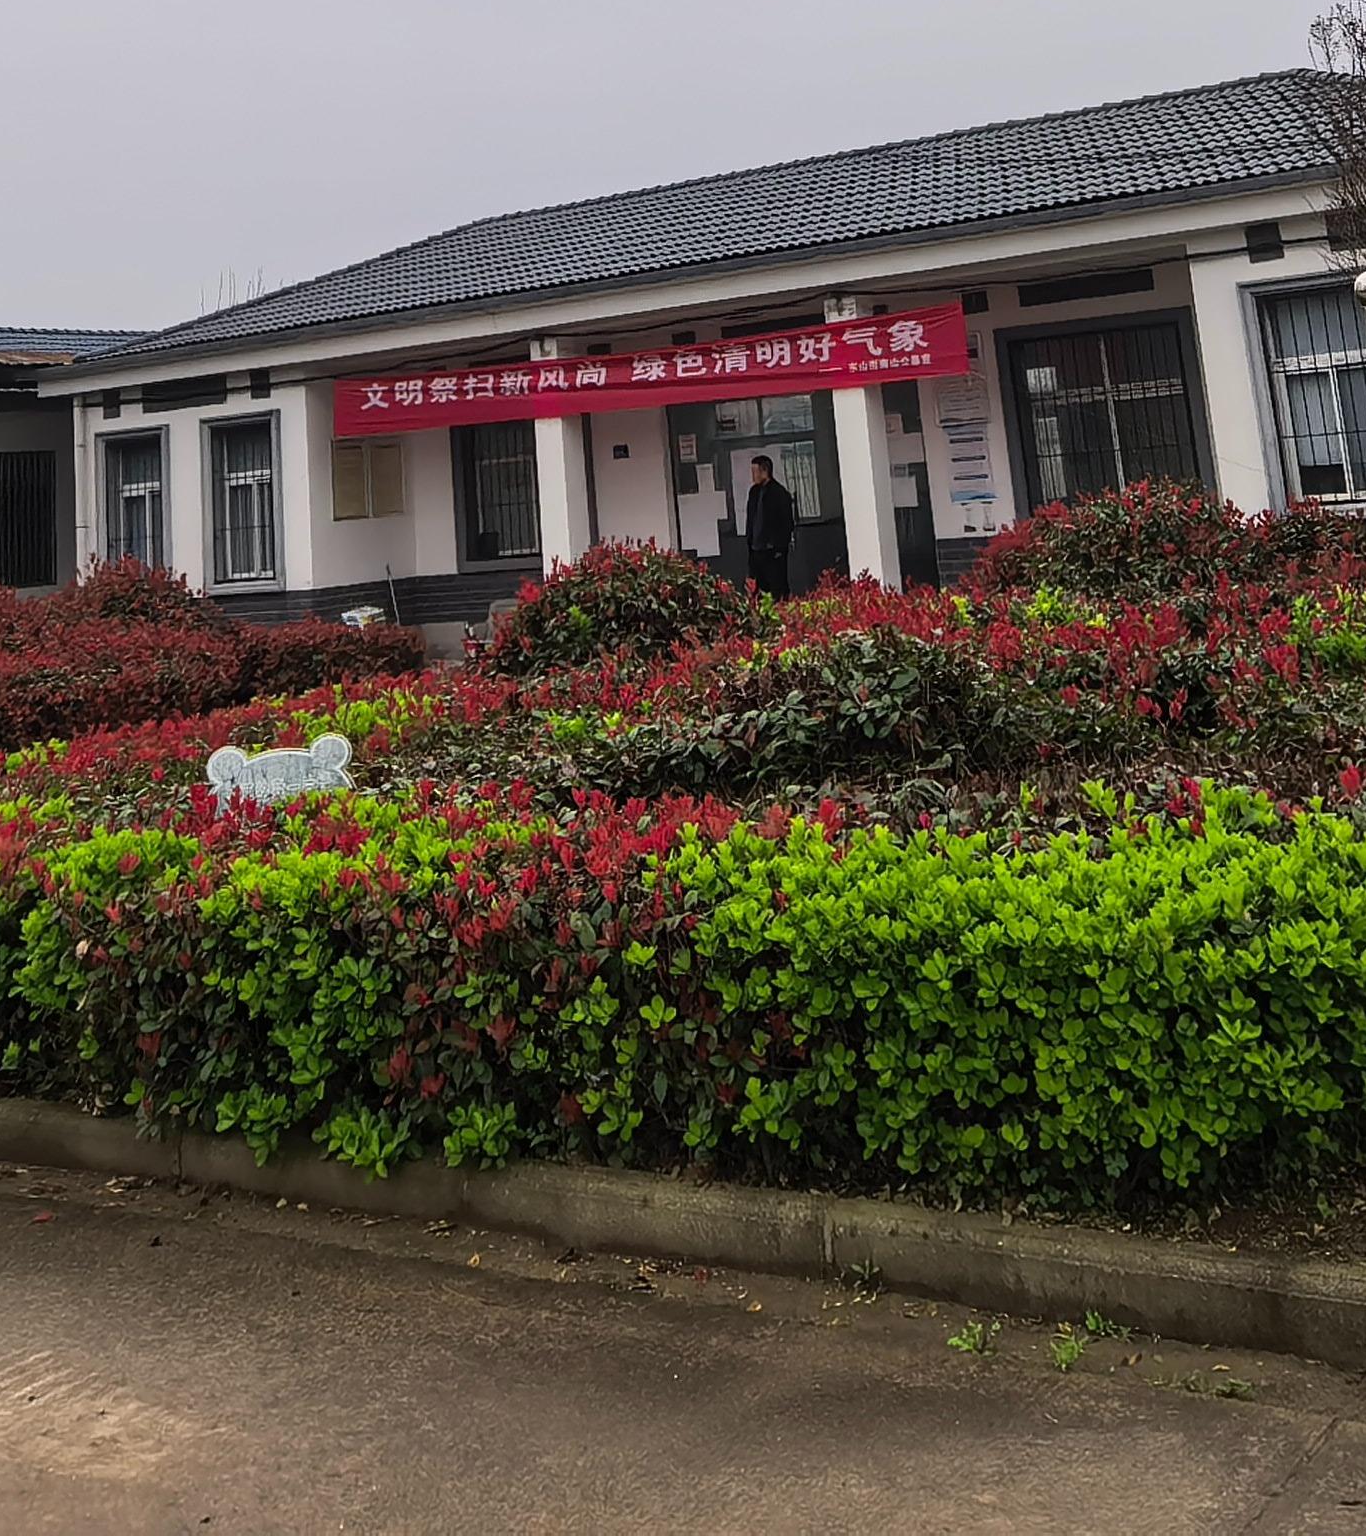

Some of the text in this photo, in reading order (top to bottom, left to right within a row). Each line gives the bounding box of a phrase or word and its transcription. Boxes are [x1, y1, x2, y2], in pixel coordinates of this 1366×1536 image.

[360, 319, 930, 411] 文明祭扫新风尚 绿色清明好气象
